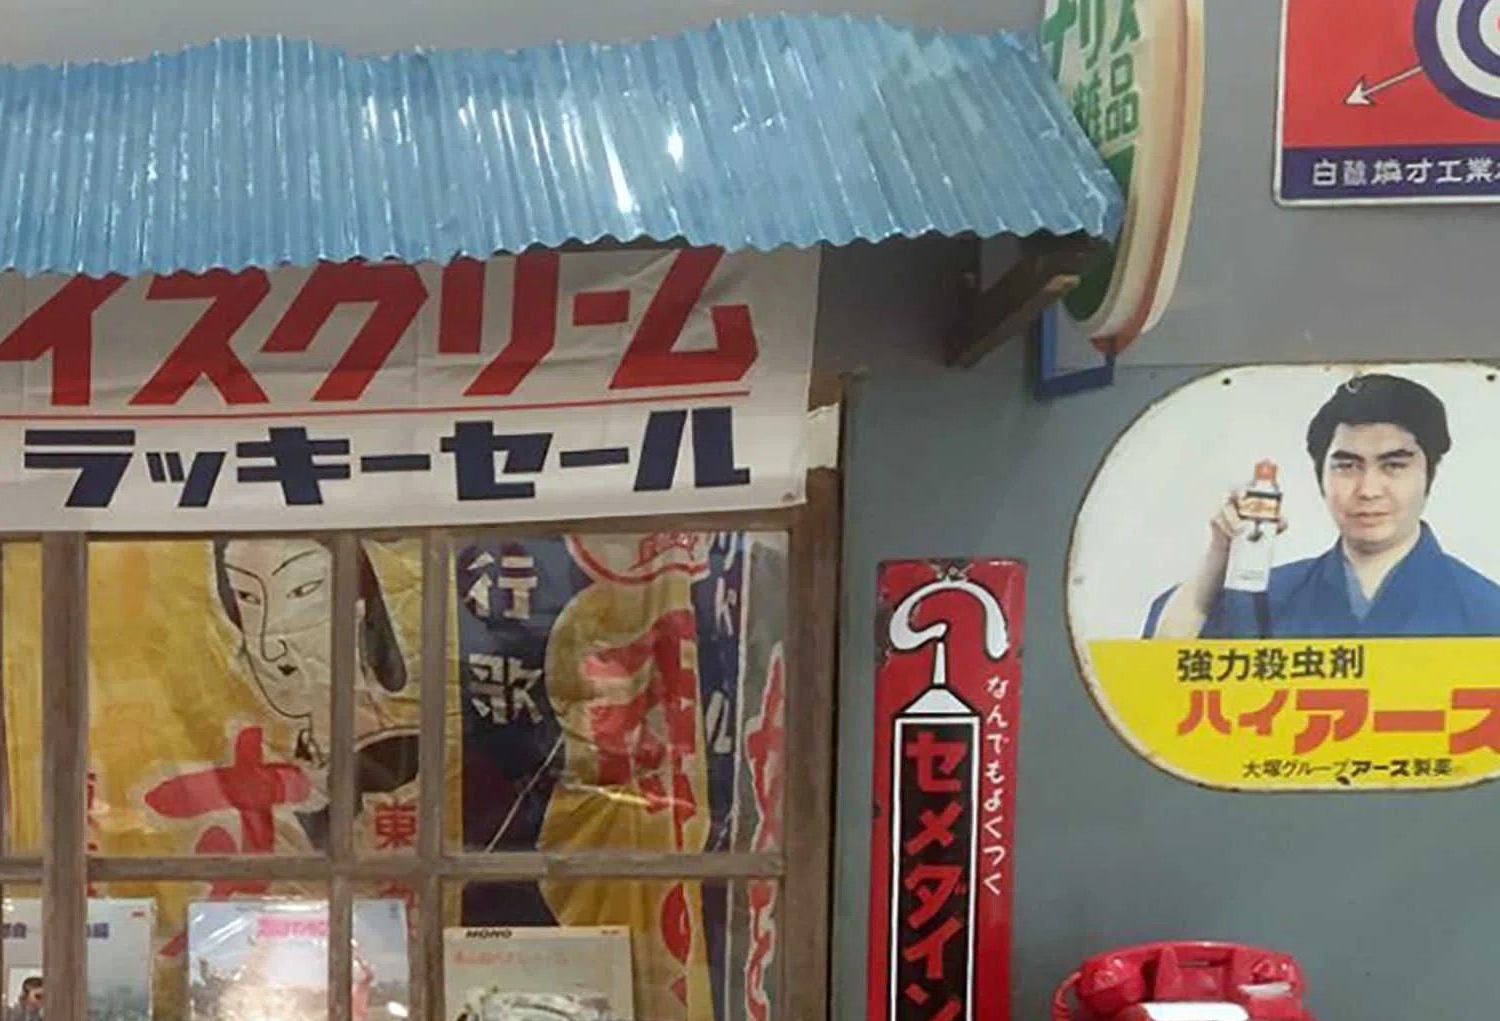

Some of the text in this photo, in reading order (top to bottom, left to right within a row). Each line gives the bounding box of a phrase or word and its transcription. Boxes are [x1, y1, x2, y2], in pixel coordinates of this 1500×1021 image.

[23, 405, 752, 508] ラッキーセール
[1176, 644, 1365, 683] 強力殺虫剤
[1176, 687, 1500, 756] ハイアース
[983, 676, 1009, 896] なんでもよくつく
